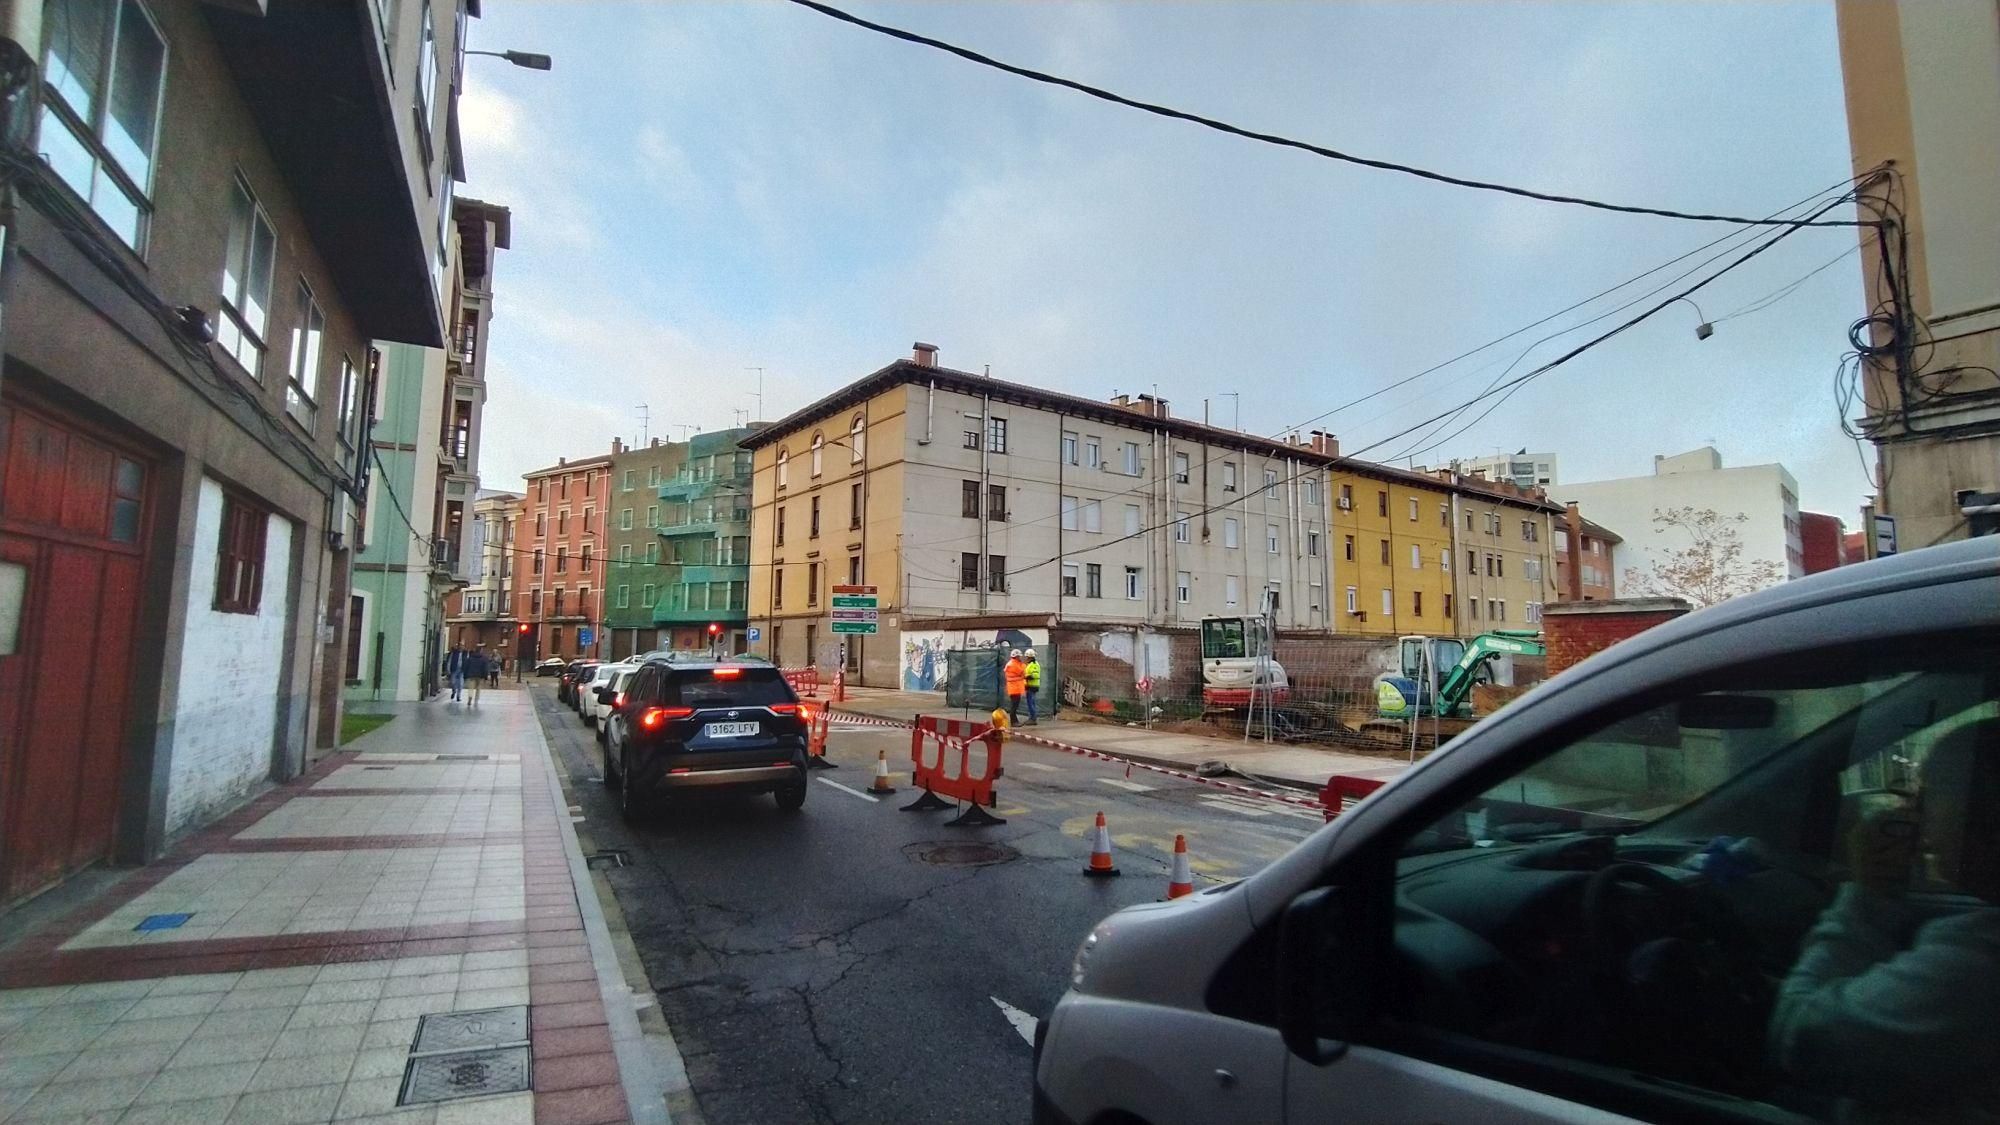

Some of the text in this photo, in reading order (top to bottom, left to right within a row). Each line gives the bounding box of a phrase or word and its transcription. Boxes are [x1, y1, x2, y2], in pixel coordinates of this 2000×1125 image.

[749, 629, 758, 640] P
[712, 723, 755, 734] 3162 LFV
